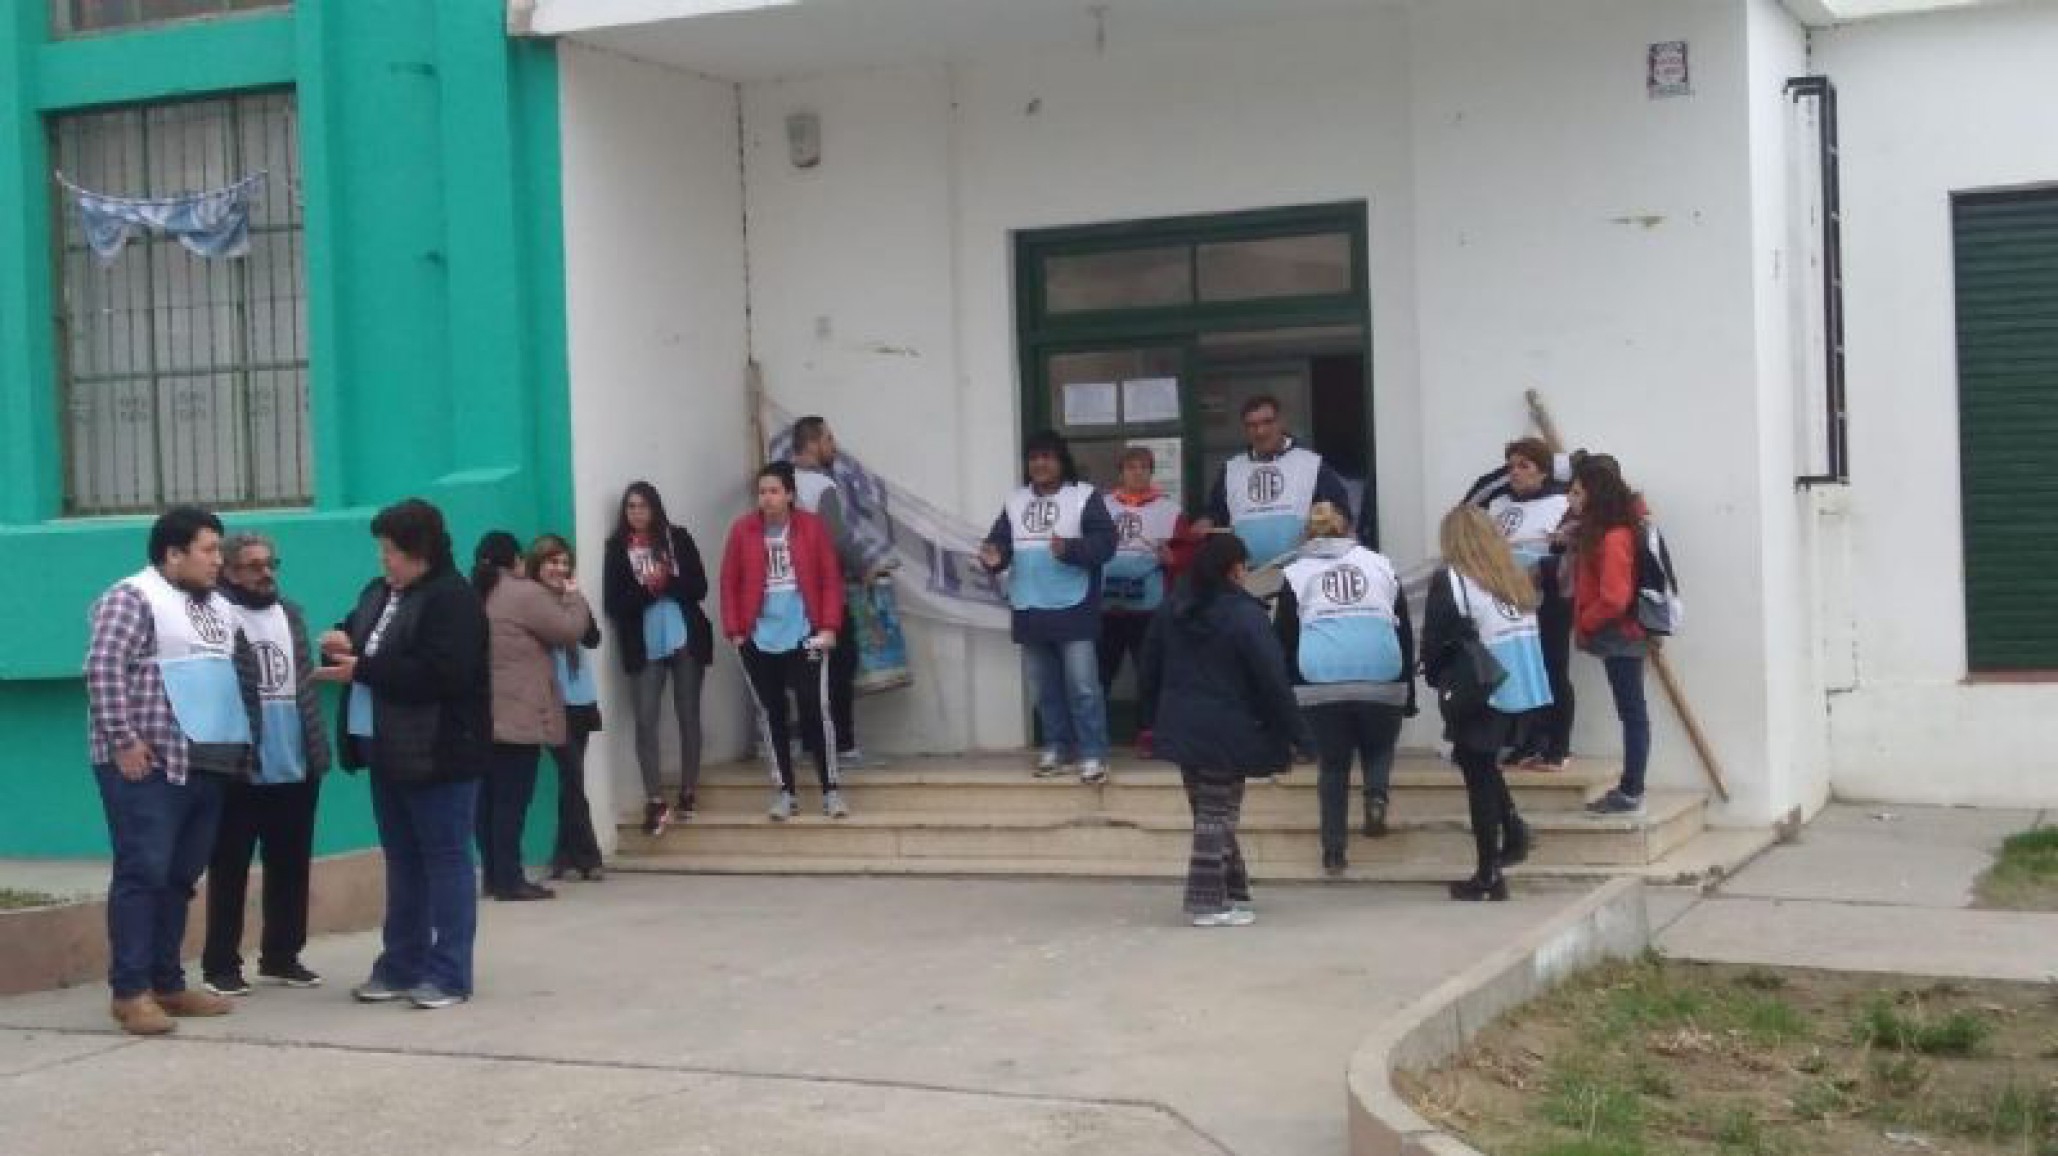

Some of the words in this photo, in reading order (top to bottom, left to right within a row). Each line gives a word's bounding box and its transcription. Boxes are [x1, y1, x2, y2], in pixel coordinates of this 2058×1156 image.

[1248, 466, 1284, 502] ATE
[1022, 493, 1060, 533] ATE
[1322, 564, 1367, 604] ATE
[258, 642, 288, 691] TE
